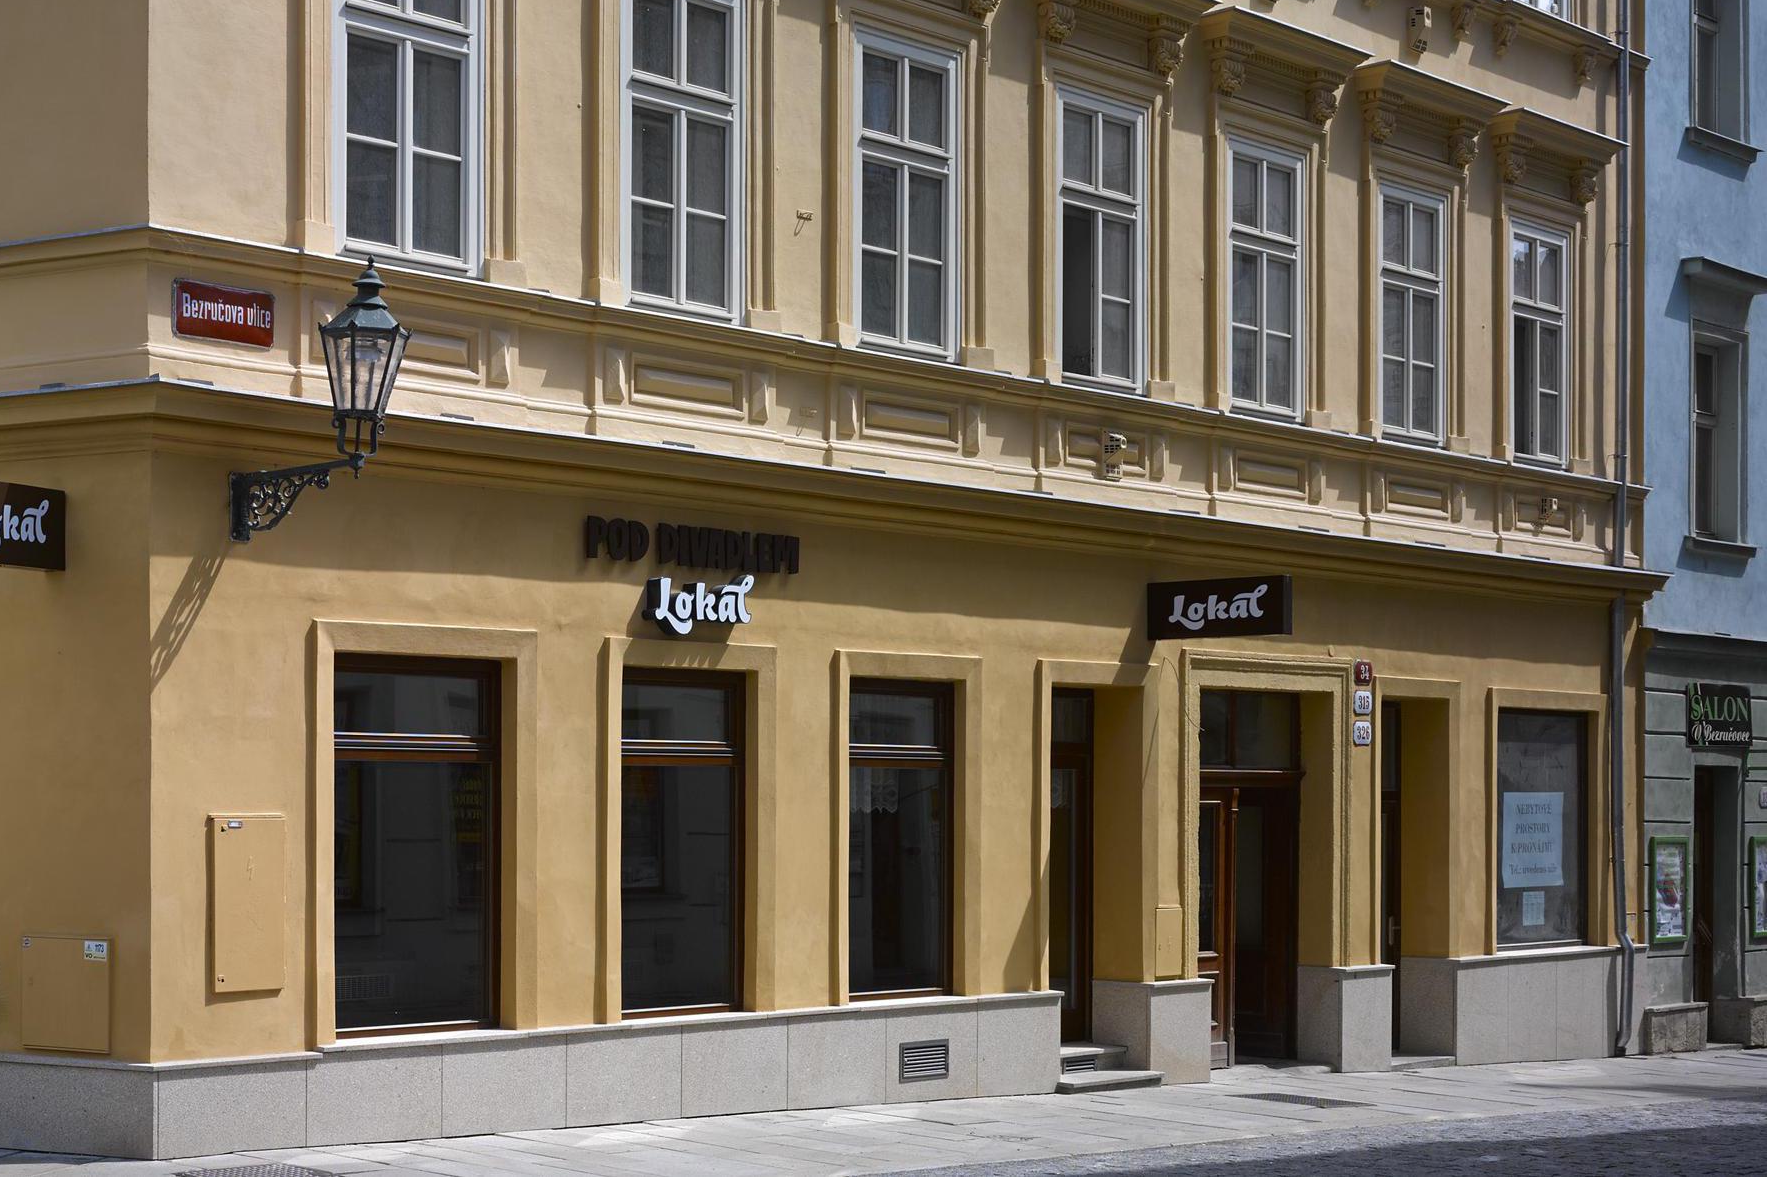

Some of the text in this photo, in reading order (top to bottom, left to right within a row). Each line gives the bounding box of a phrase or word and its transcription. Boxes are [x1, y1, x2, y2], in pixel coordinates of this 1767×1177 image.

[182, 292, 271, 329] Bezručova ulice
[587, 515, 800, 575] POD DIVADLEM
[1690, 694, 1749, 721] SALON
[1515, 822, 1551, 834] PROSTORY
